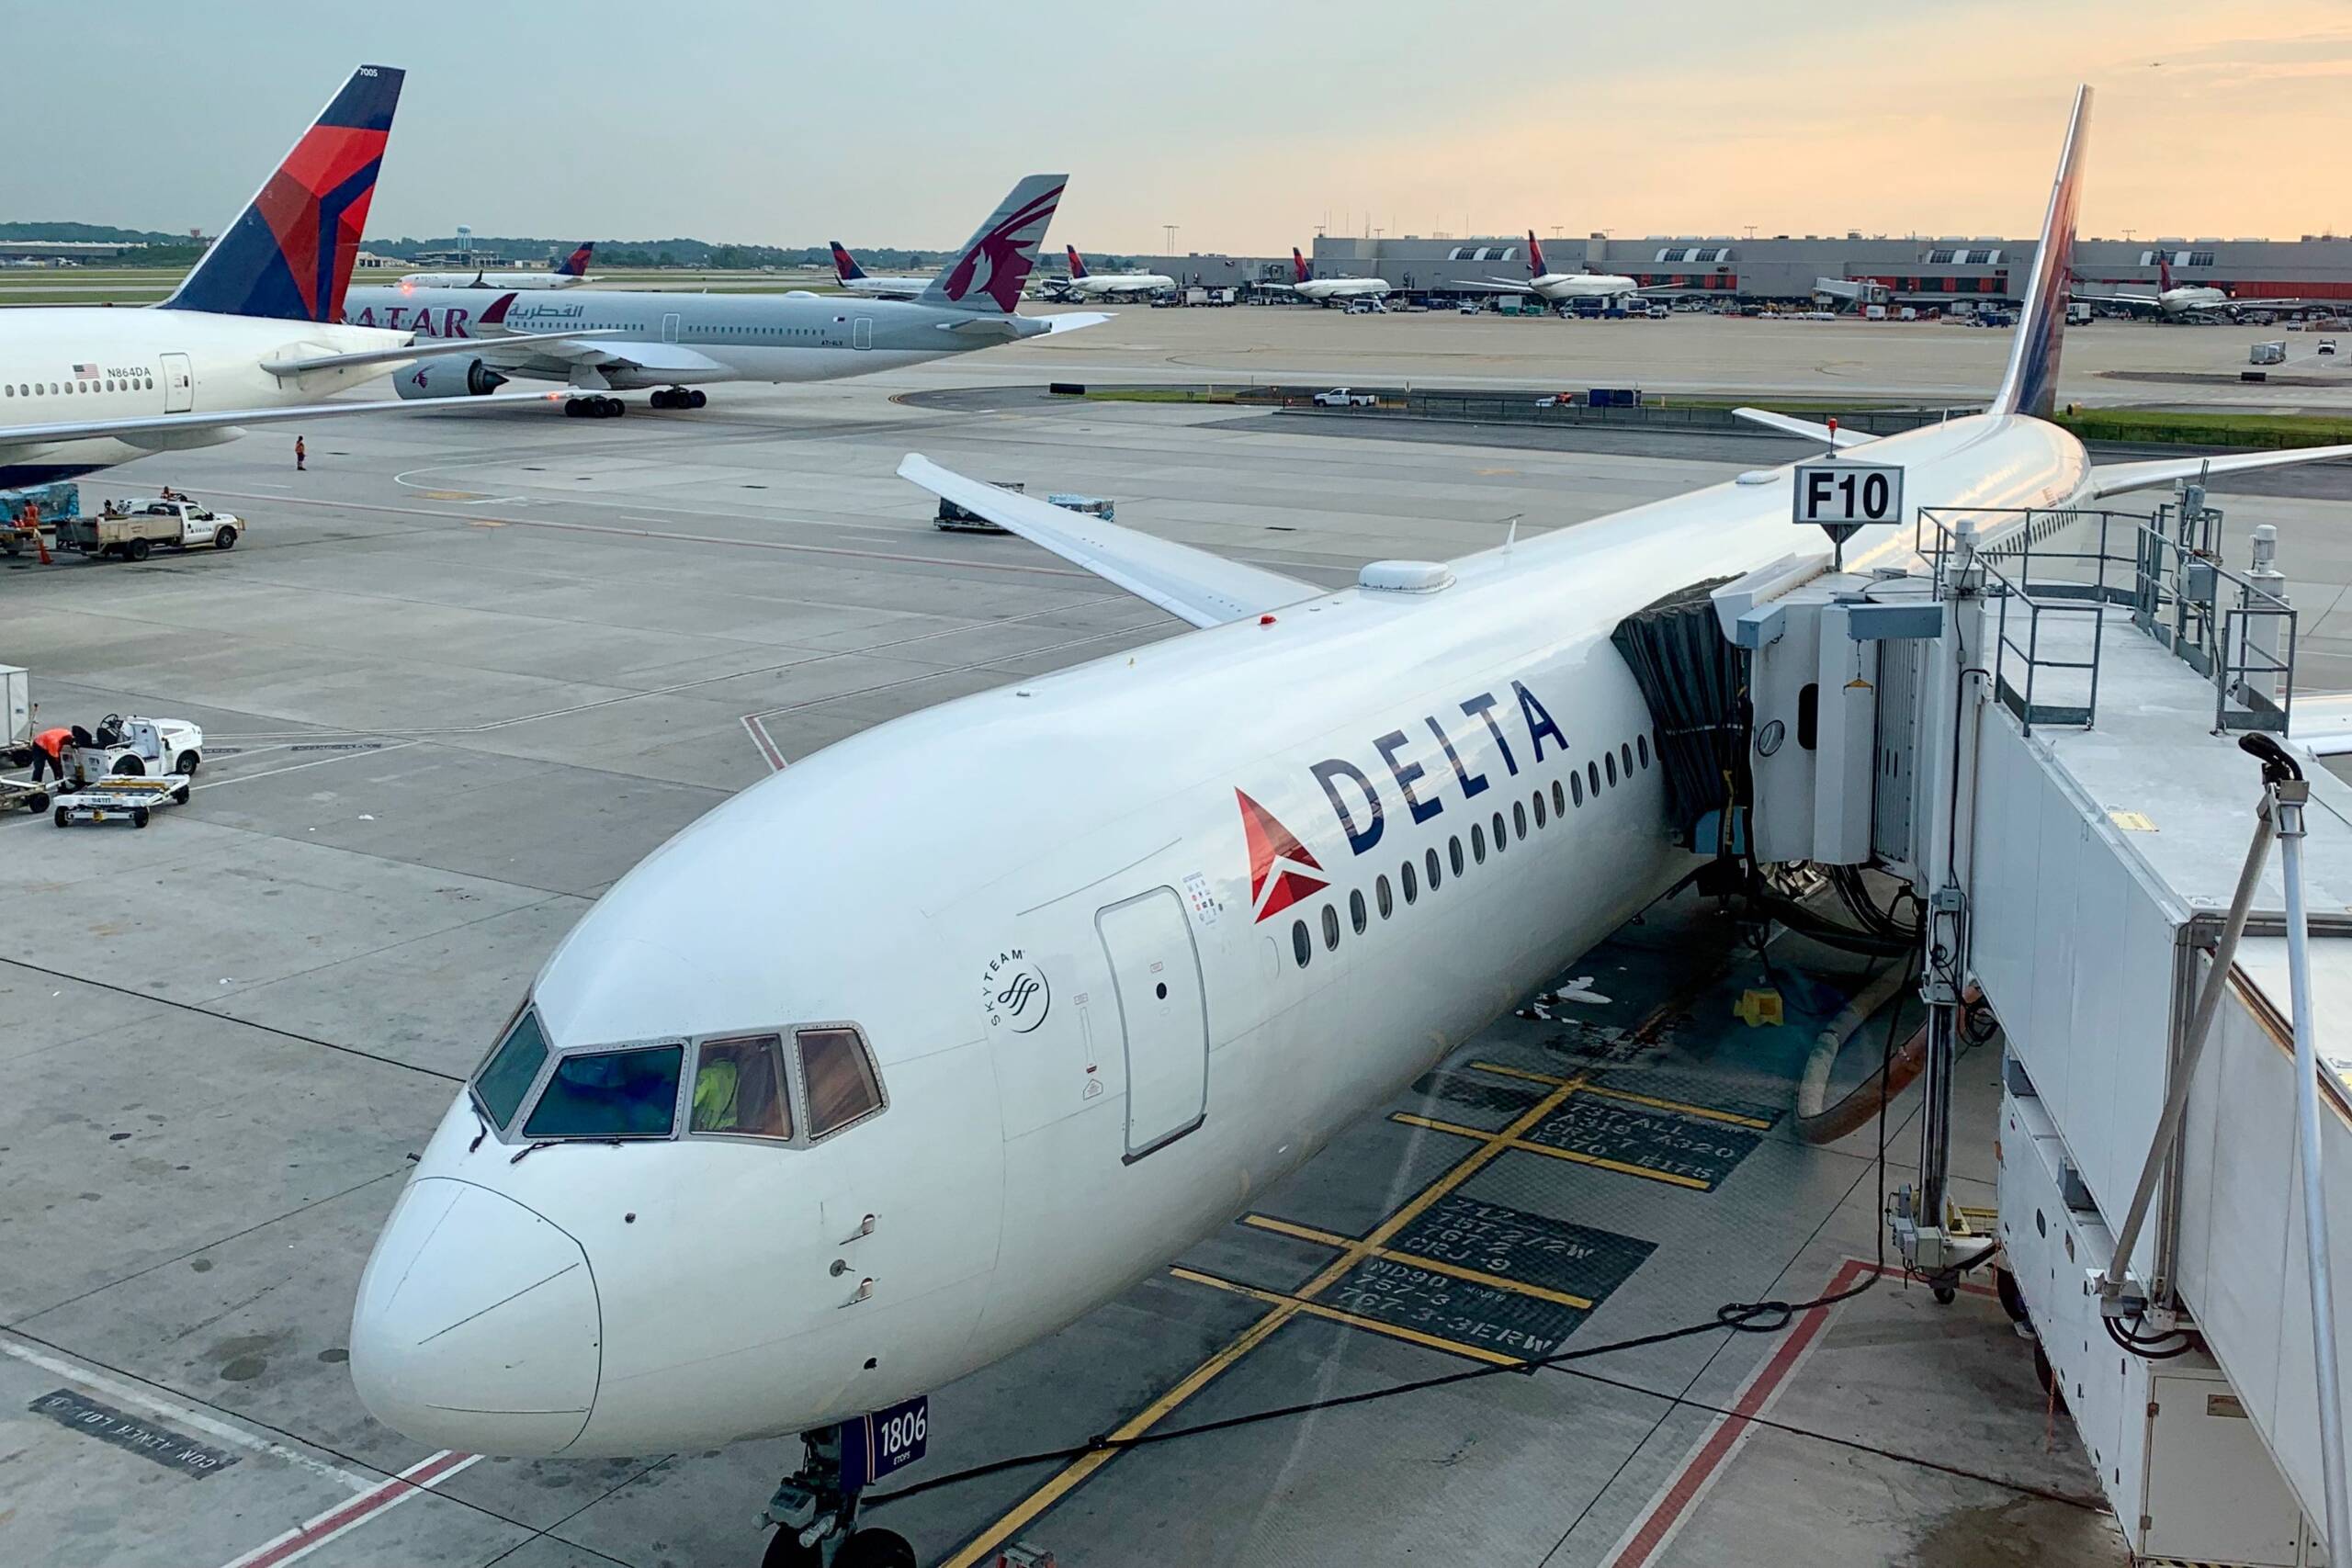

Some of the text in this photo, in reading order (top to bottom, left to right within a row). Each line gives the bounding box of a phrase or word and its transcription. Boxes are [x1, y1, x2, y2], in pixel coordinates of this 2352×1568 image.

[359, 67, 379, 78] 7005
[341, 307, 470, 338] ATAR
[107, 367, 152, 378] N864DA
[1807, 472, 1889, 520] F10
[1309, 680, 1569, 856] DELTA
[982, 949, 1023, 1027] SKYTEAM
[1354, 1273, 1452, 1306] 757-3
[1369, 1260, 1449, 1287] MD90
[881, 1405, 926, 1457] 1806
